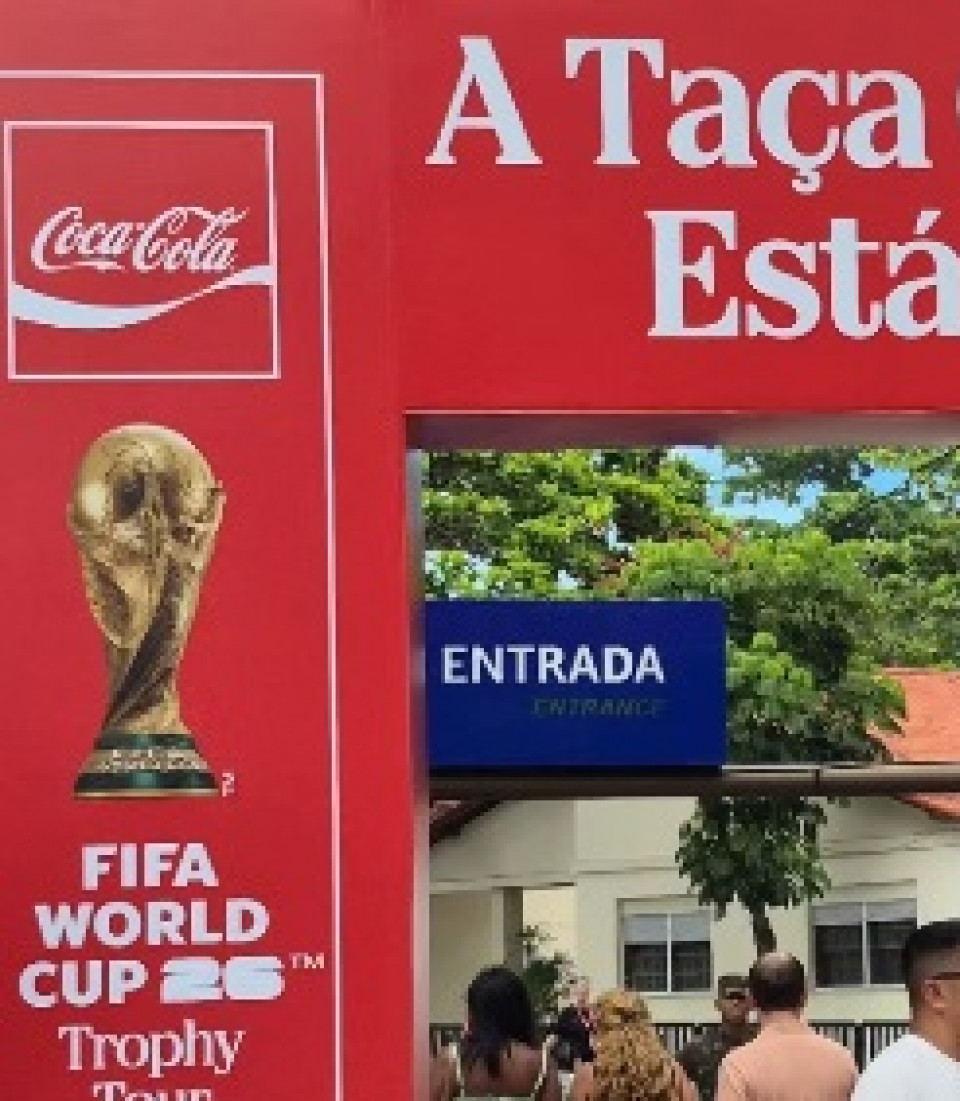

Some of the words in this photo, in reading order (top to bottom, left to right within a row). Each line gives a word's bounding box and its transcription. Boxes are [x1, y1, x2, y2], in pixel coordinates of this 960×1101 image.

[425, 36, 543, 166] A
[564, 37, 933, 195] Taça
[443, 646, 665, 684] ENTRADA
[533, 697, 664, 718] ENTRANCE
[81, 842, 219, 890] FIFA
[34, 898, 270, 949] WORLD
[19, 959, 149, 1008] CUP
[58, 1018, 246, 1078] Trophy
